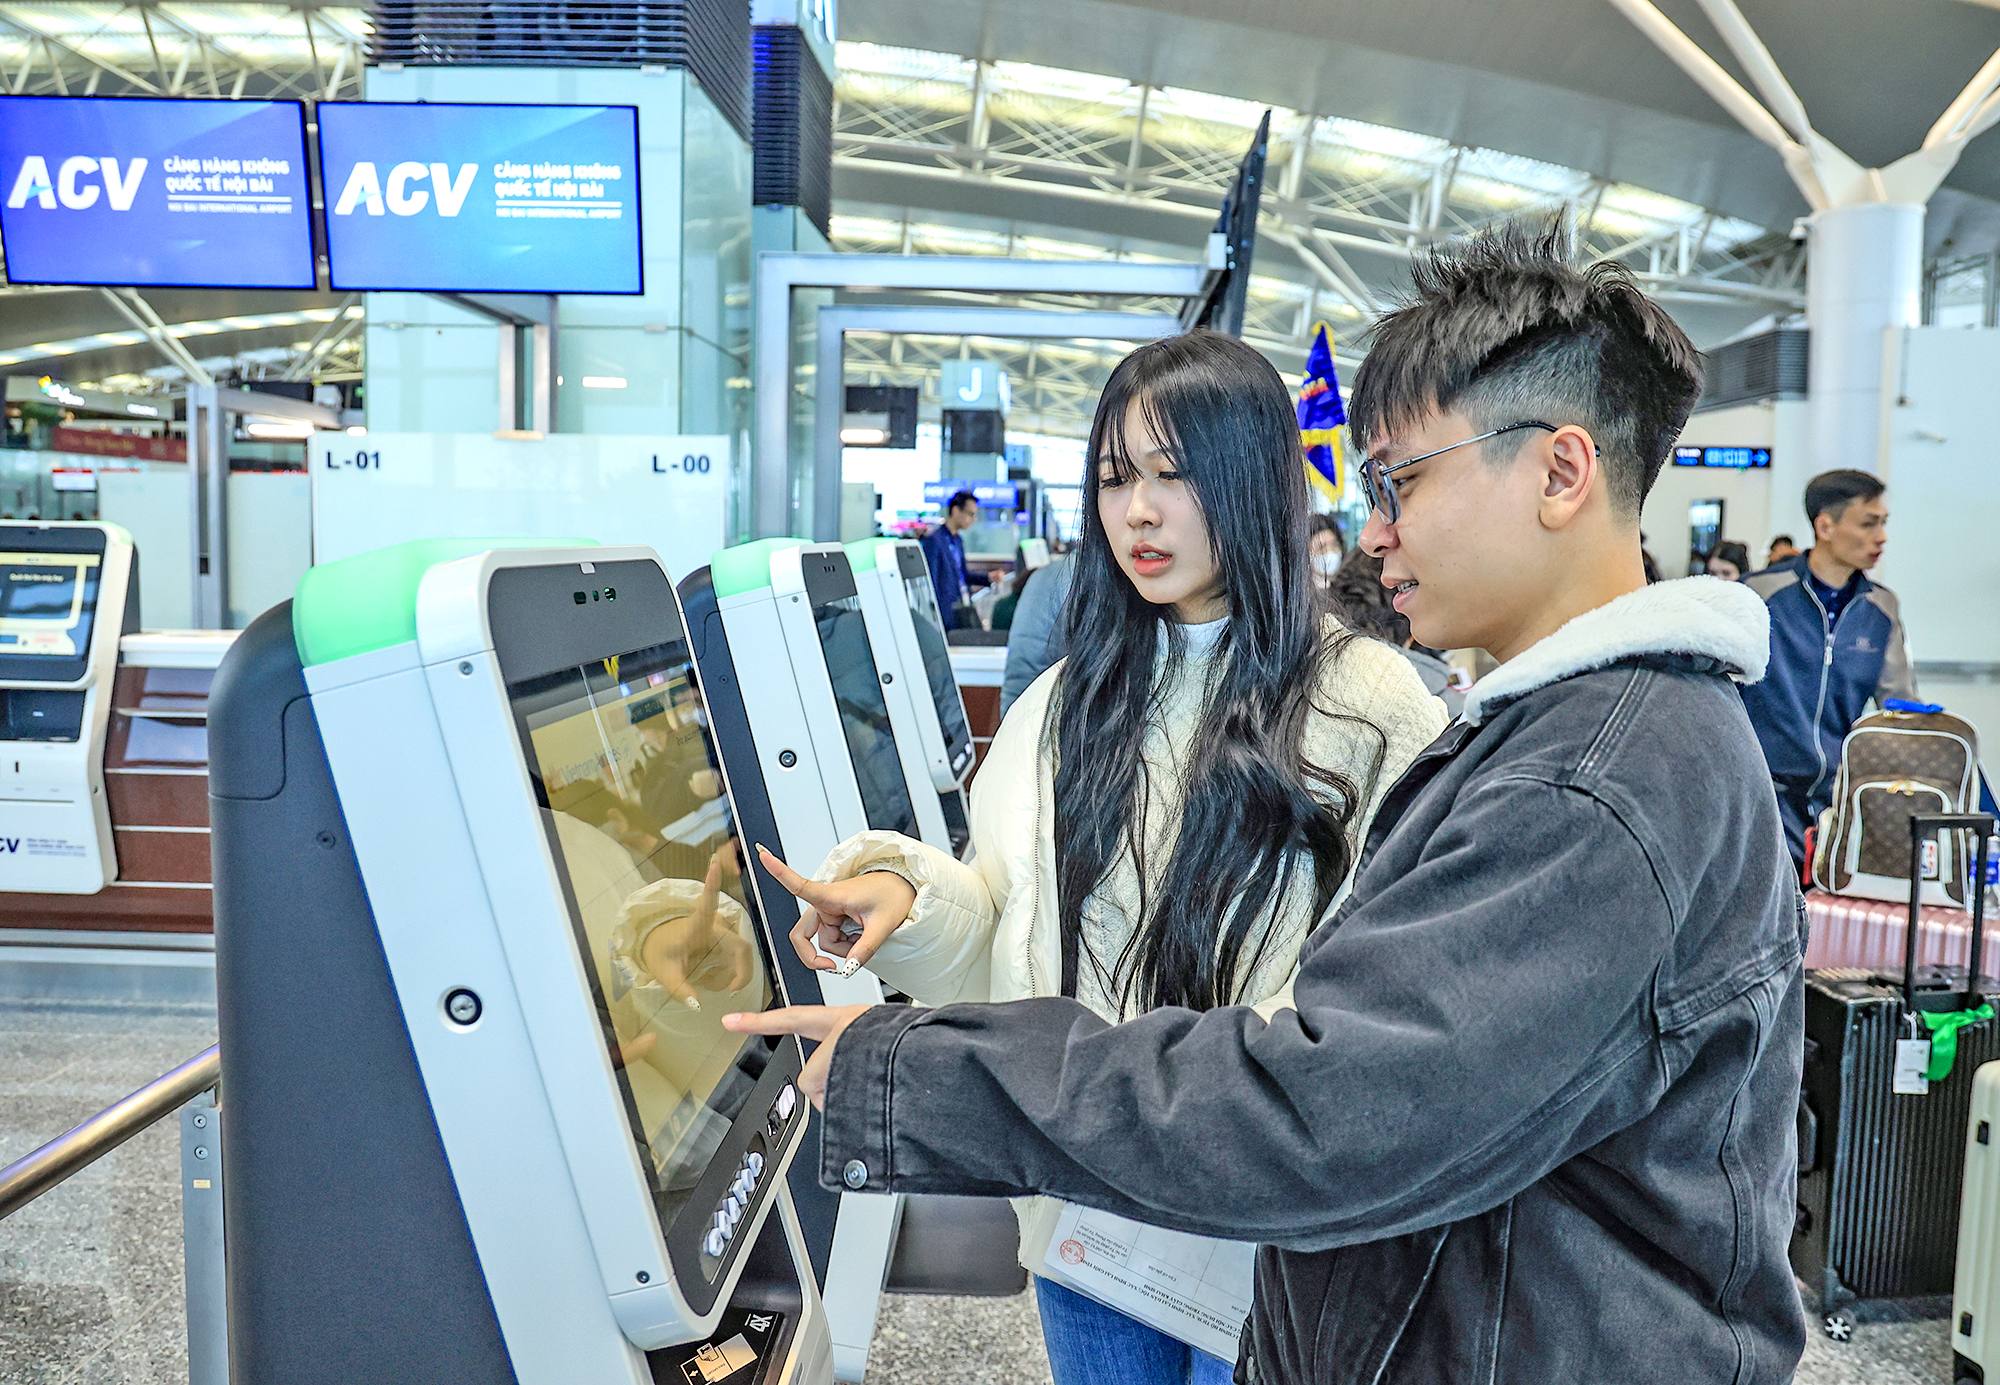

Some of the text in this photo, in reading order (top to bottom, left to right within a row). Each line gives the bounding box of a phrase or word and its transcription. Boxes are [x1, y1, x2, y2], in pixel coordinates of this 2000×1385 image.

[242, 157, 290, 174] KHÔNG
[7, 155, 148, 211] ACV
[334, 161, 479, 217] ACV
[958, 366, 983, 402] J
[326, 451, 381, 470] L-01
[652, 454, 711, 474] L-00
